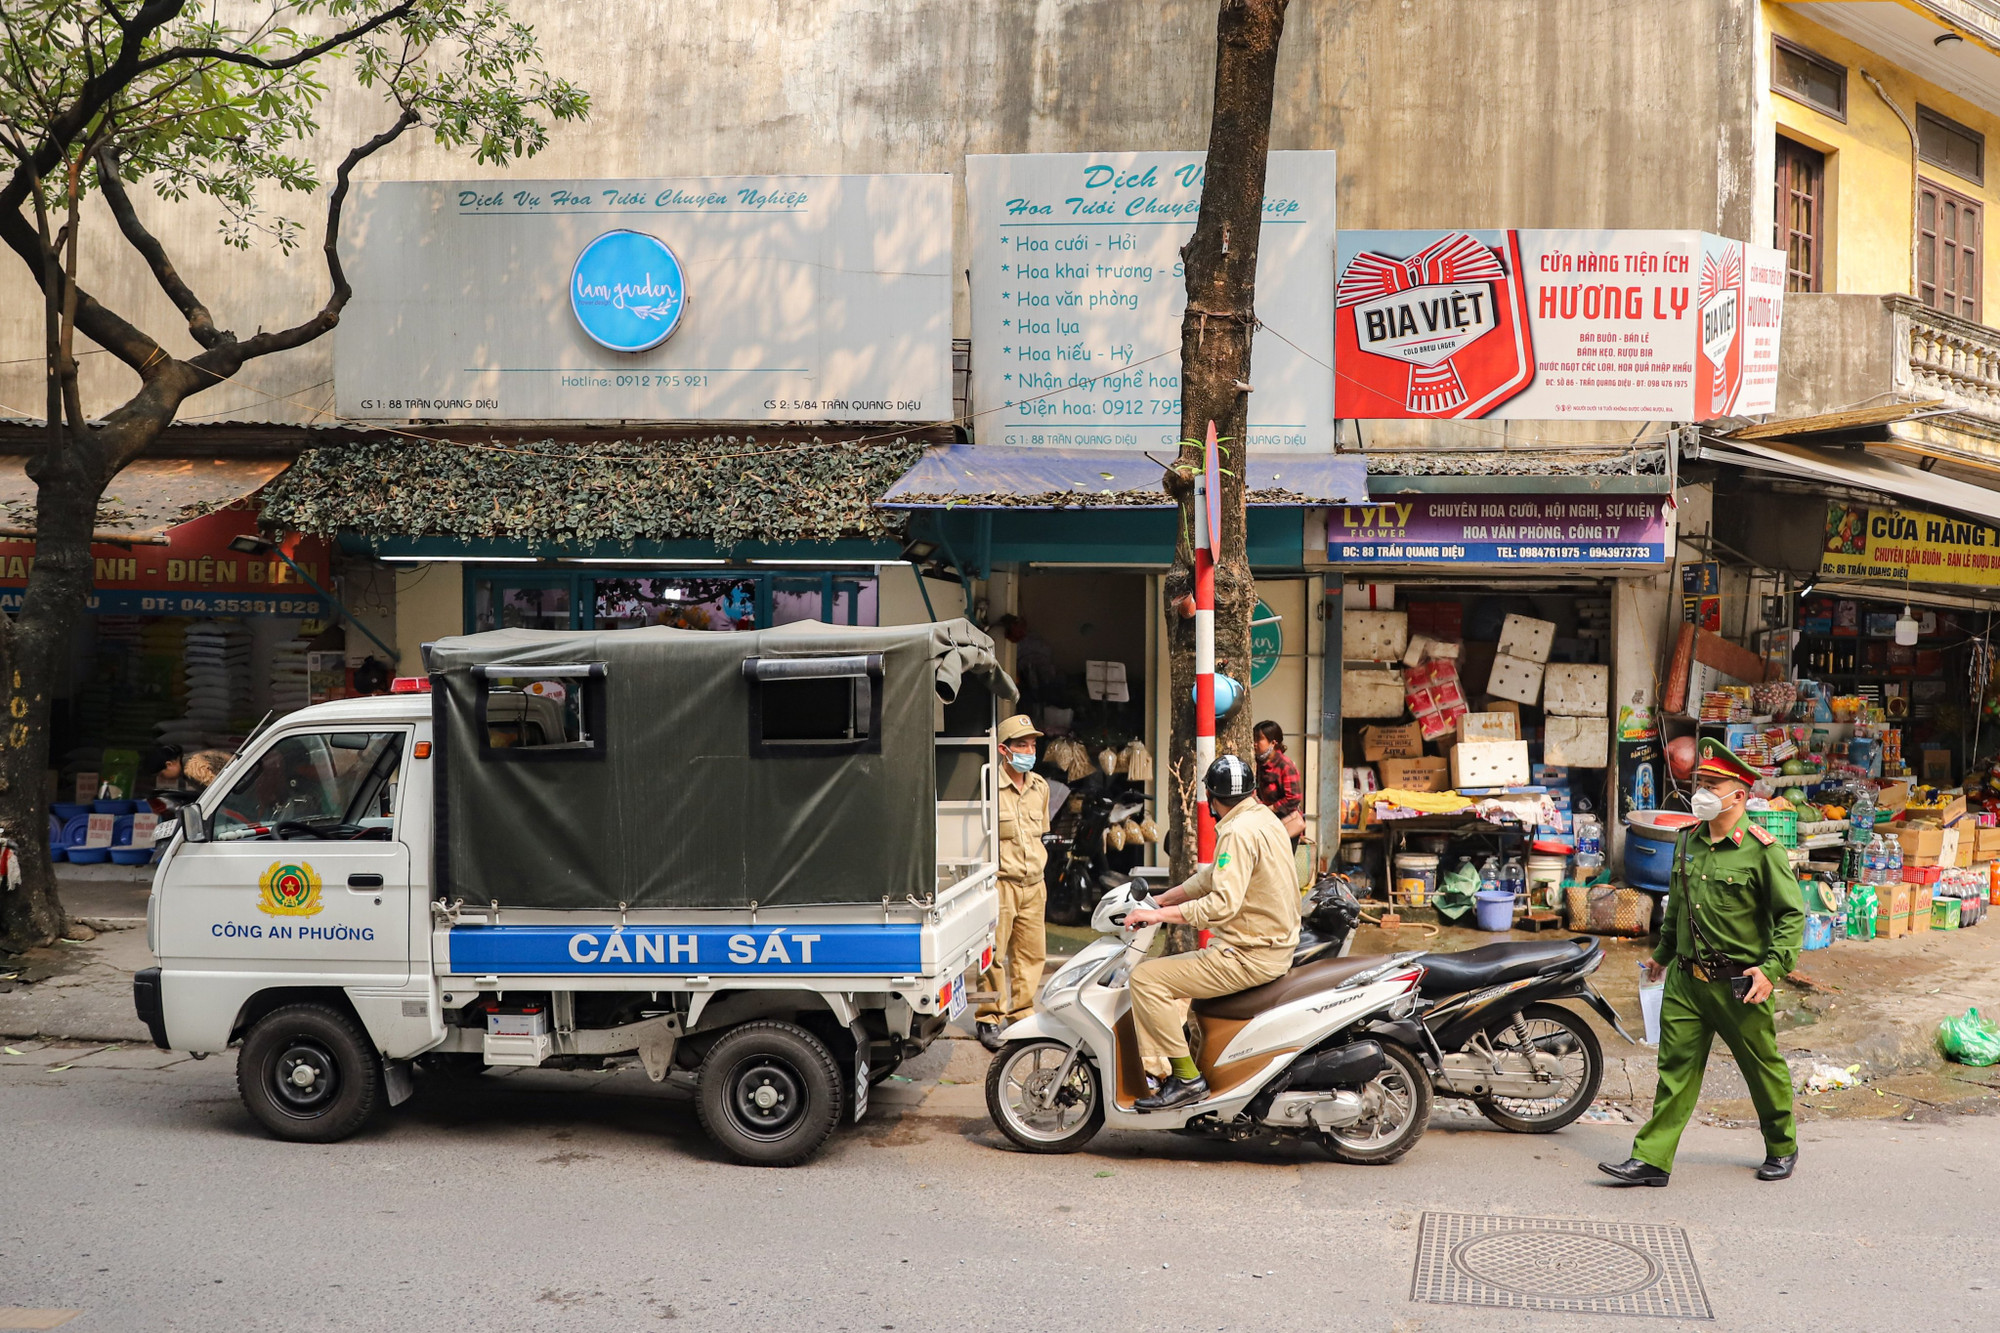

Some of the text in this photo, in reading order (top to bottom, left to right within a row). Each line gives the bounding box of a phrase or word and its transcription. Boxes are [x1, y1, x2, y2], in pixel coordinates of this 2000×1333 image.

[1083, 163, 1205, 194] Dịch V
[458, 190, 503, 210] Dịch
[513, 190, 540, 209] Vụ
[551, 189, 592, 205] Hoa
[655, 189, 727, 208] Chuyên
[737, 189, 808, 208] Nghiệp
[1005, 198, 1053, 217] Hoa
[1016, 232, 1137, 252] Hoa cưới Hỏi
[1541, 250, 1689, 276] CỬA HÀNG TIỆN ÍCH
[1017, 262, 1153, 284] Hoa khai trương
[577, 272, 676, 309] lam garden
[1017, 291, 1138, 310] Hoa văn phòng
[1539, 284, 1689, 320] HƯƠNG LY
[1364, 289, 1483, 342] BIA VIỆT
[1705, 296, 1735, 345] BIA VIỆT
[1018, 318, 1080, 338] Hoa lụa
[1580, 332, 1649, 343] BÁN BUÔN BÁN LẺ
[1018, 343, 1134, 366] Hoa hiếu Hỷ
[1403, 341, 1456, 356] COLD BREW LAGER
[1577, 347, 1597, 357] BÁNH
[1618, 348, 1638, 358] RƯỢU
[1640, 348, 1653, 357] BIA
[1539, 361, 1559, 371] NƯỚC
[1561, 362, 1580, 373] NGỌT
[1582, 361, 1596, 372] CÁC
[1618, 363, 1633, 372] HOA
[1635, 362, 1649, 373] QUẢ
[1651, 362, 1671, 374] NHẬP
[1673, 361, 1692, 373] KHẨU
[562, 375, 708, 387] Hotline: 0912 795 921
[1019, 370, 1178, 393] Nhận dạy nghề hoa
[1596, 379, 1617, 388] QUANG
[1618, 379, 1632, 388] DIỆU
[1648, 380, 1660, 388] 098
[1661, 380, 1673, 388] 476
[1674, 380, 1688, 388] 1975
[361, 399, 373, 409] CS
[389, 399, 402, 409] 88
[434, 399, 473, 410] QUANG
[475, 398, 499, 410] DIỆU
[763, 400, 777, 410] CS
[794, 400, 818, 410] 5/84
[852, 400, 893, 411] QUANG
[897, 399, 921, 411] DIỆU
[1019, 399, 1182, 418] Điện hoa: 0912 795
[1005, 434, 1016, 445] CS
[1032, 434, 1044, 445] 88
[1075, 434, 1113, 446] QUANG
[1116, 433, 1137, 446] DIỆU
[1161, 434, 1173, 445] CS
[1284, 433, 1306, 446] DIỆU
[1429, 502, 1477, 518] CHUYÊN
[1481, 504, 1505, 518] HOA
[1509, 502, 1541, 519] CƯỚI,
[1606, 503, 1623, 520] SỰ
[1626, 502, 1655, 520] KIỆN
[1351, 529, 1406, 538] FLOWER
[1463, 523, 1620, 540] HOA VĂN PHÒNG, CÔNG TY
[1872, 511, 1918, 541] CỬA
[1926, 519, 1985, 547] HÀNG
[1343, 546, 1359, 557] ĐC:
[1362, 546, 1374, 557] 88
[1406, 547, 1440, 558] QUANG
[1441, 545, 1465, 559] DIỆU
[1497, 547, 1517, 558] TEL:
[1519, 547, 1580, 558] 0984761975
[1589, 547, 1650, 558] 0943973733
[166, 555, 237, 587] ĐIỆN
[1823, 563, 1835, 573] ĐC:
[1836, 564, 1846, 574] 86
[141, 597, 320, 614] ĐT: 04.35381928
[211, 921, 375, 941] CÔNG AN PHƯỜNG
[568, 924, 821, 964] CẢNH SÁT
